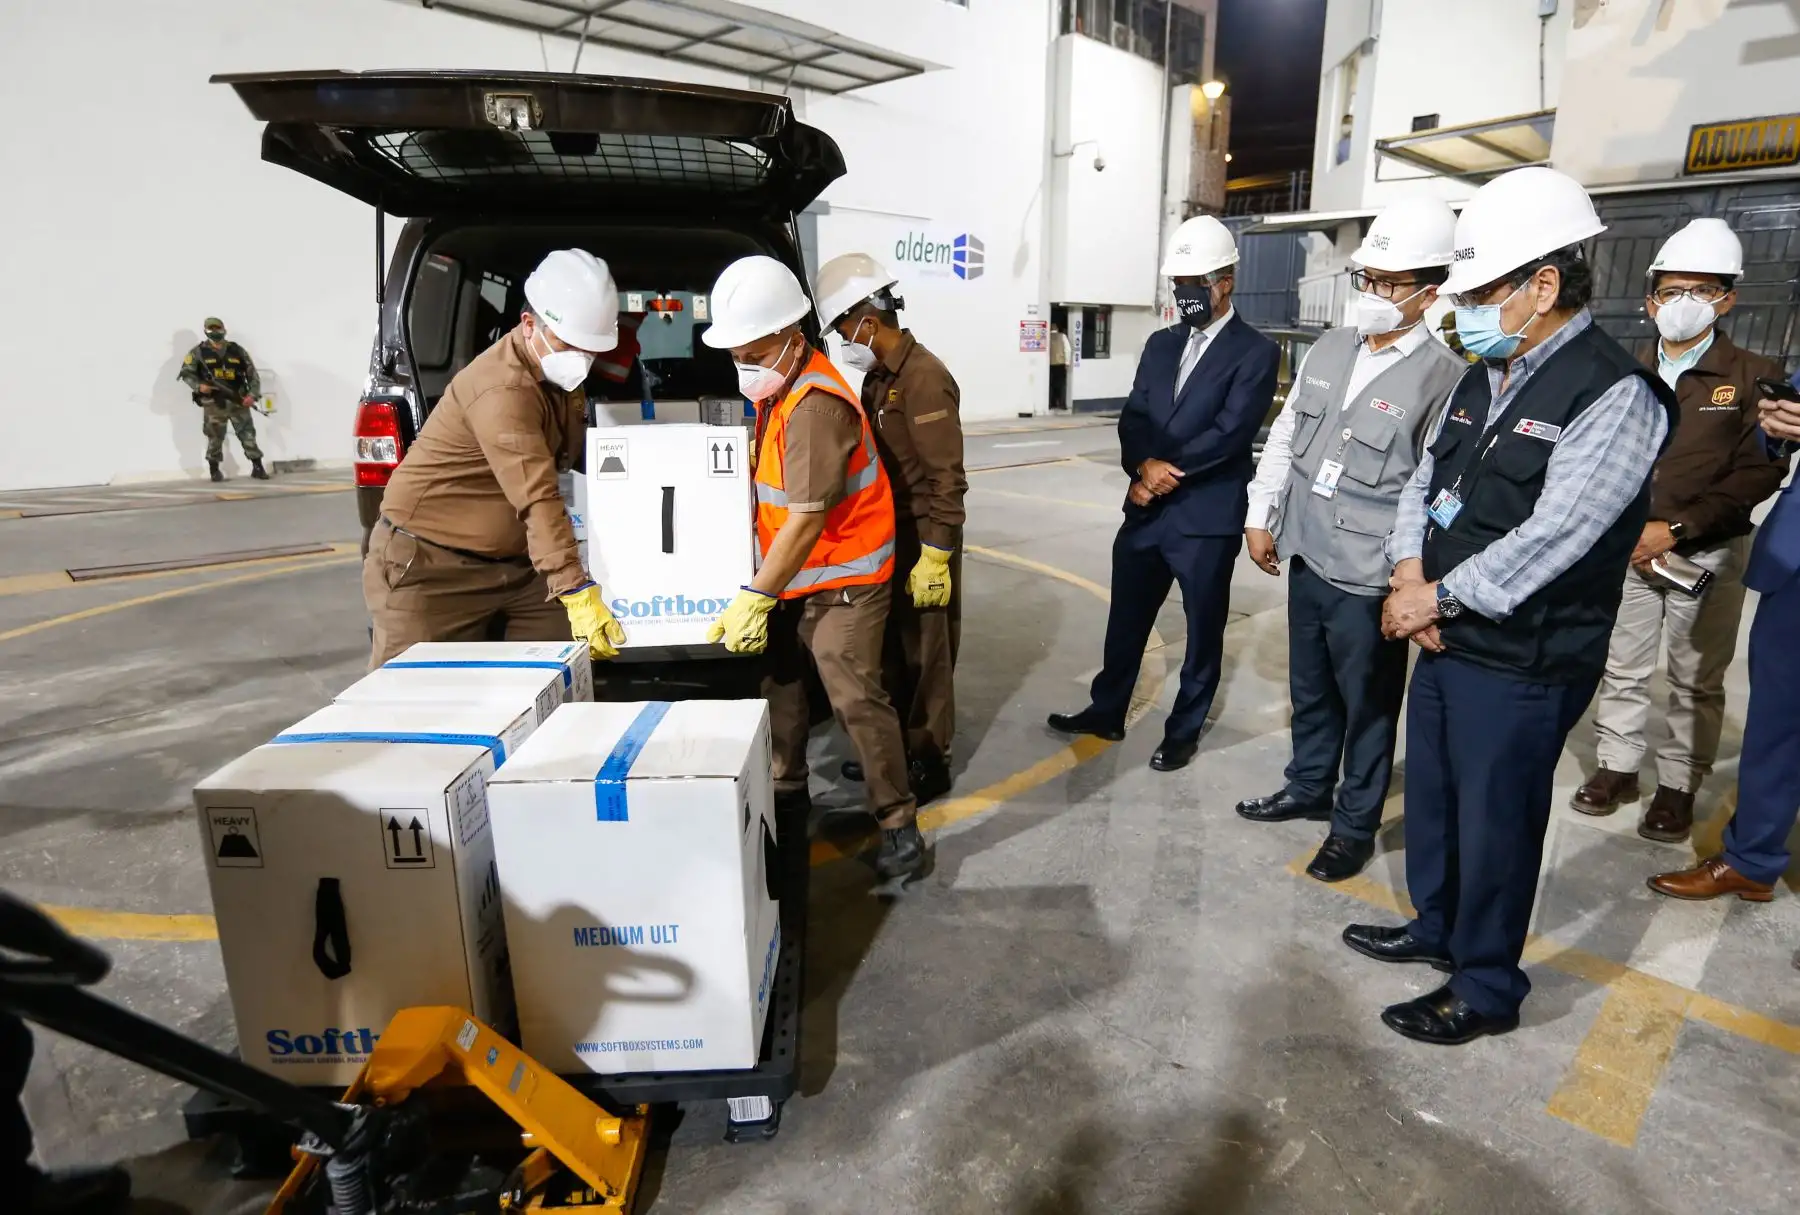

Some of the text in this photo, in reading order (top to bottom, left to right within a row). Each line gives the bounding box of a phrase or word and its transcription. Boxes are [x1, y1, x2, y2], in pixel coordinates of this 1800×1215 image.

[1691, 122, 1794, 168] ADUANA
[895, 231, 951, 264] aldem
[1185, 304, 1204, 315] WIN
[1713, 391, 1733, 402] ups
[600, 443, 624, 451] HEAVY
[611, 594, 732, 619] Softbox
[213, 816, 251, 826] HEAVY
[573, 924, 680, 947] MEDIUM ULT
[573, 1038, 705, 1053] WWW.SOFTBOXSYSTEMS.COM
